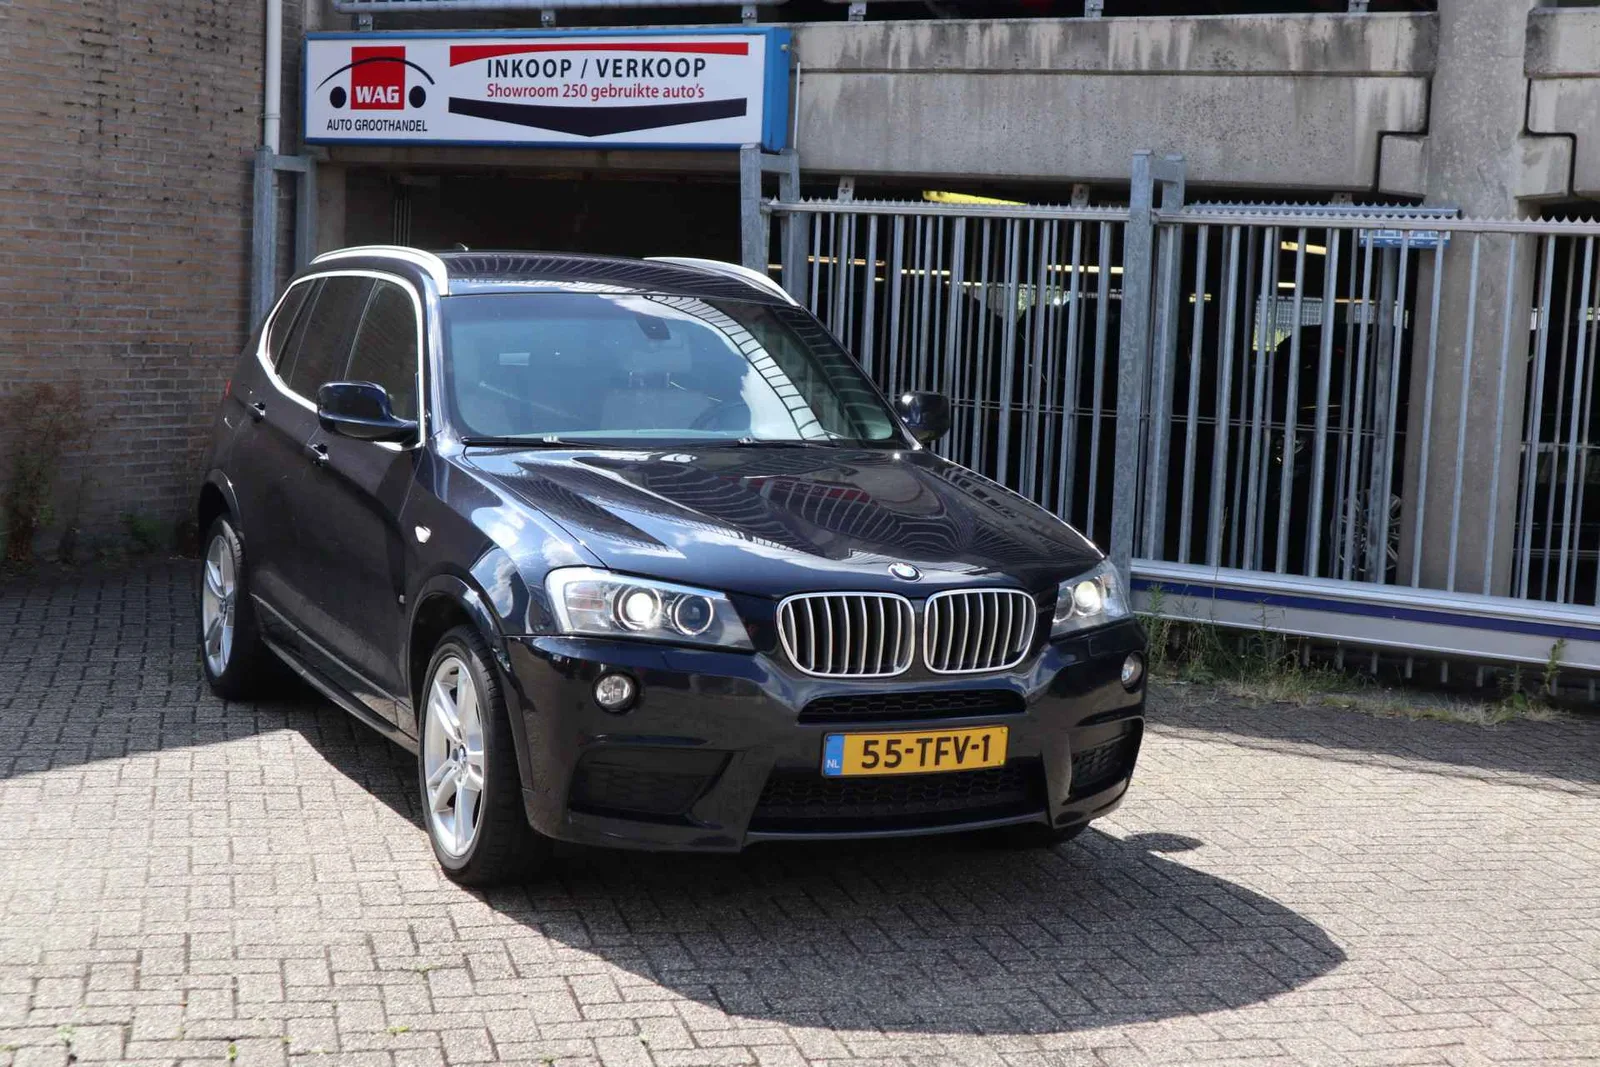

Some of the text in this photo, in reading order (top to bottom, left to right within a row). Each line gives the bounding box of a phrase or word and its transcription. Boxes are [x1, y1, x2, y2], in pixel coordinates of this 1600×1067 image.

[487, 58, 706, 79] INKOOP / VERKOOP
[355, 85, 400, 104] WAG
[487, 83, 705, 102] Showroom 250 gebruikte auto's
[327, 119, 428, 132] AUTO GROOTHANDEL
[861, 734, 992, 769] 55-TFV-1
[826, 759, 841, 769] NL
